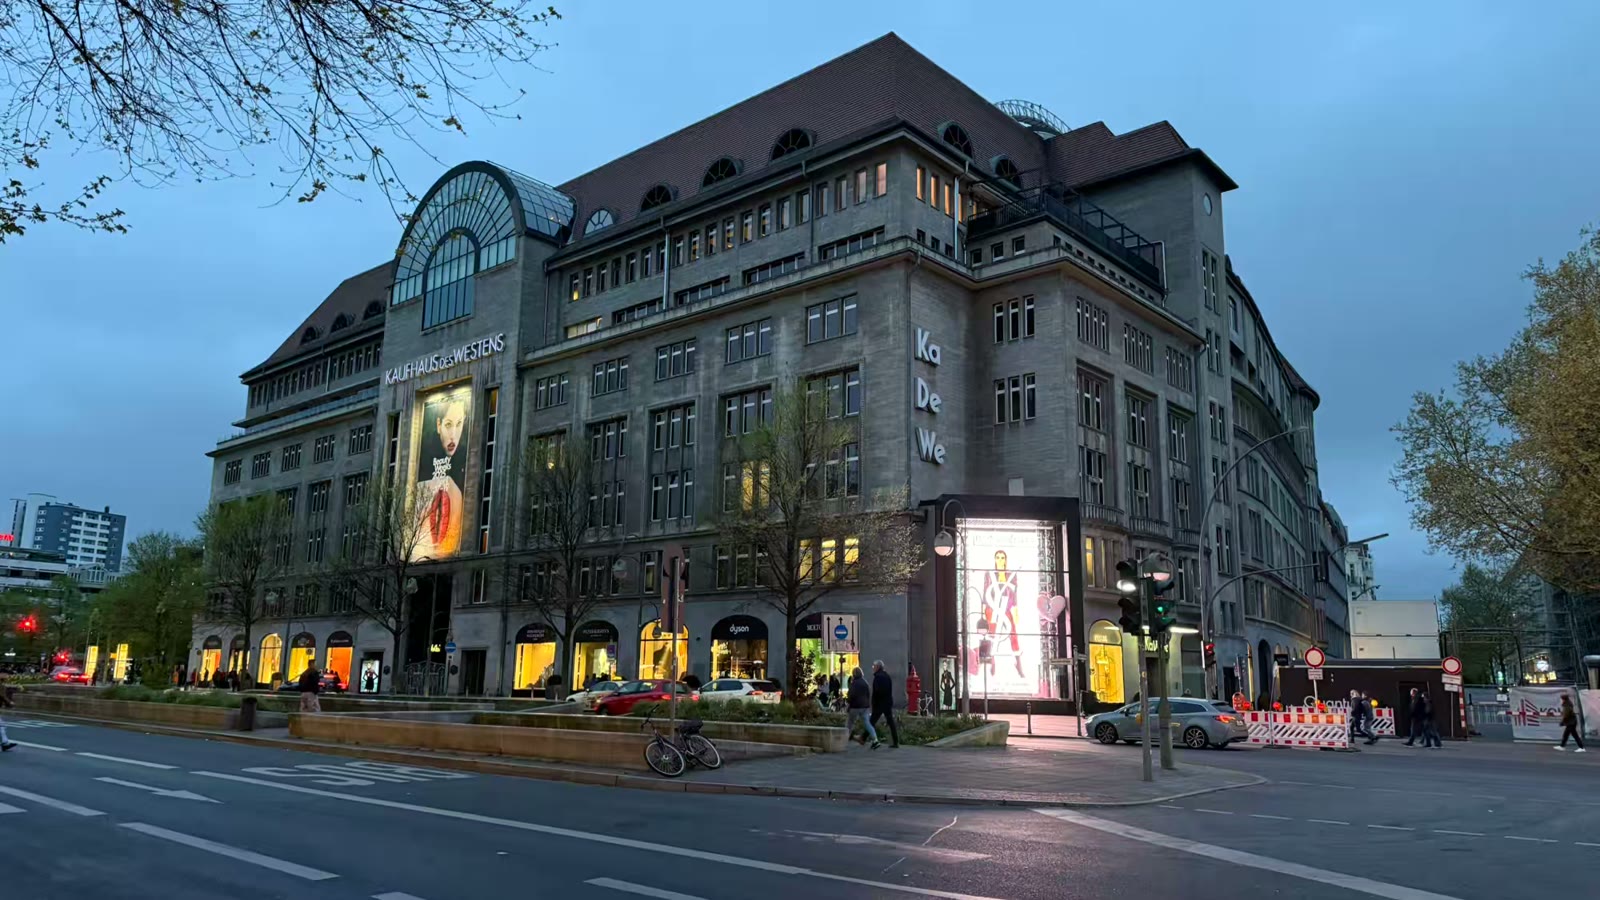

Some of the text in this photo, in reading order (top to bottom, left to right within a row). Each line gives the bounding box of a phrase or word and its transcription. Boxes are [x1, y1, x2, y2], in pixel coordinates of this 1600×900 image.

[385, 333, 504, 385] KAUFHAUS DES WESTENS
[915, 327, 941, 365] Ka
[914, 377, 942, 414] De
[915, 427, 946, 465] We
[730, 624, 749, 634] dyson
